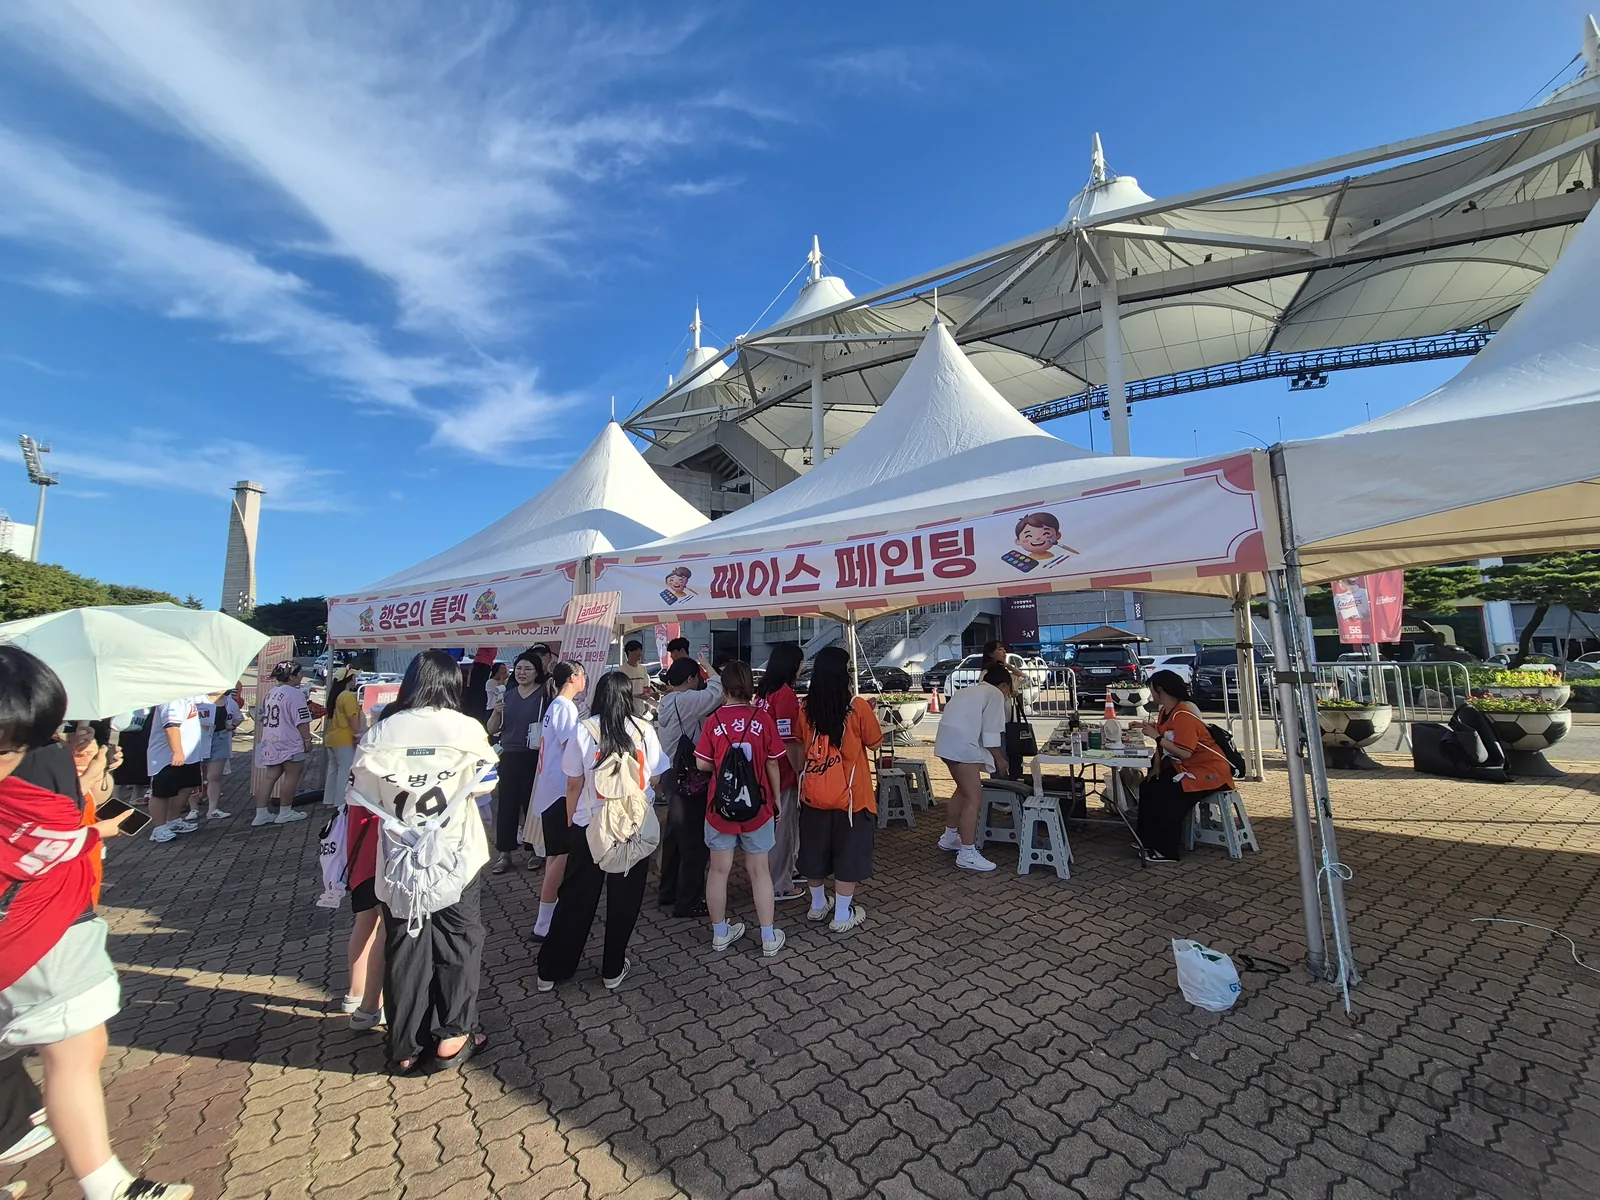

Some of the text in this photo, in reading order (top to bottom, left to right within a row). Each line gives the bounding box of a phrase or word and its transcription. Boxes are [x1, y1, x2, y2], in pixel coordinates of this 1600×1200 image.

[710, 526, 977, 600] 페이스 페인팅
[379, 593, 469, 632] 행운의 룰렛
[575, 602, 609, 625] Landers
[1022, 629, 1035, 639] SAY
[1349, 626, 1361, 634] 56
[266, 642, 287, 657] Landers
[576, 636, 597, 648] 랜더스
[561, 650, 606, 662] 페이스 페인팅
[714, 718, 763, 737] 박성한
[805, 754, 841, 776] Eagles
[393, 786, 451, 829] 19
